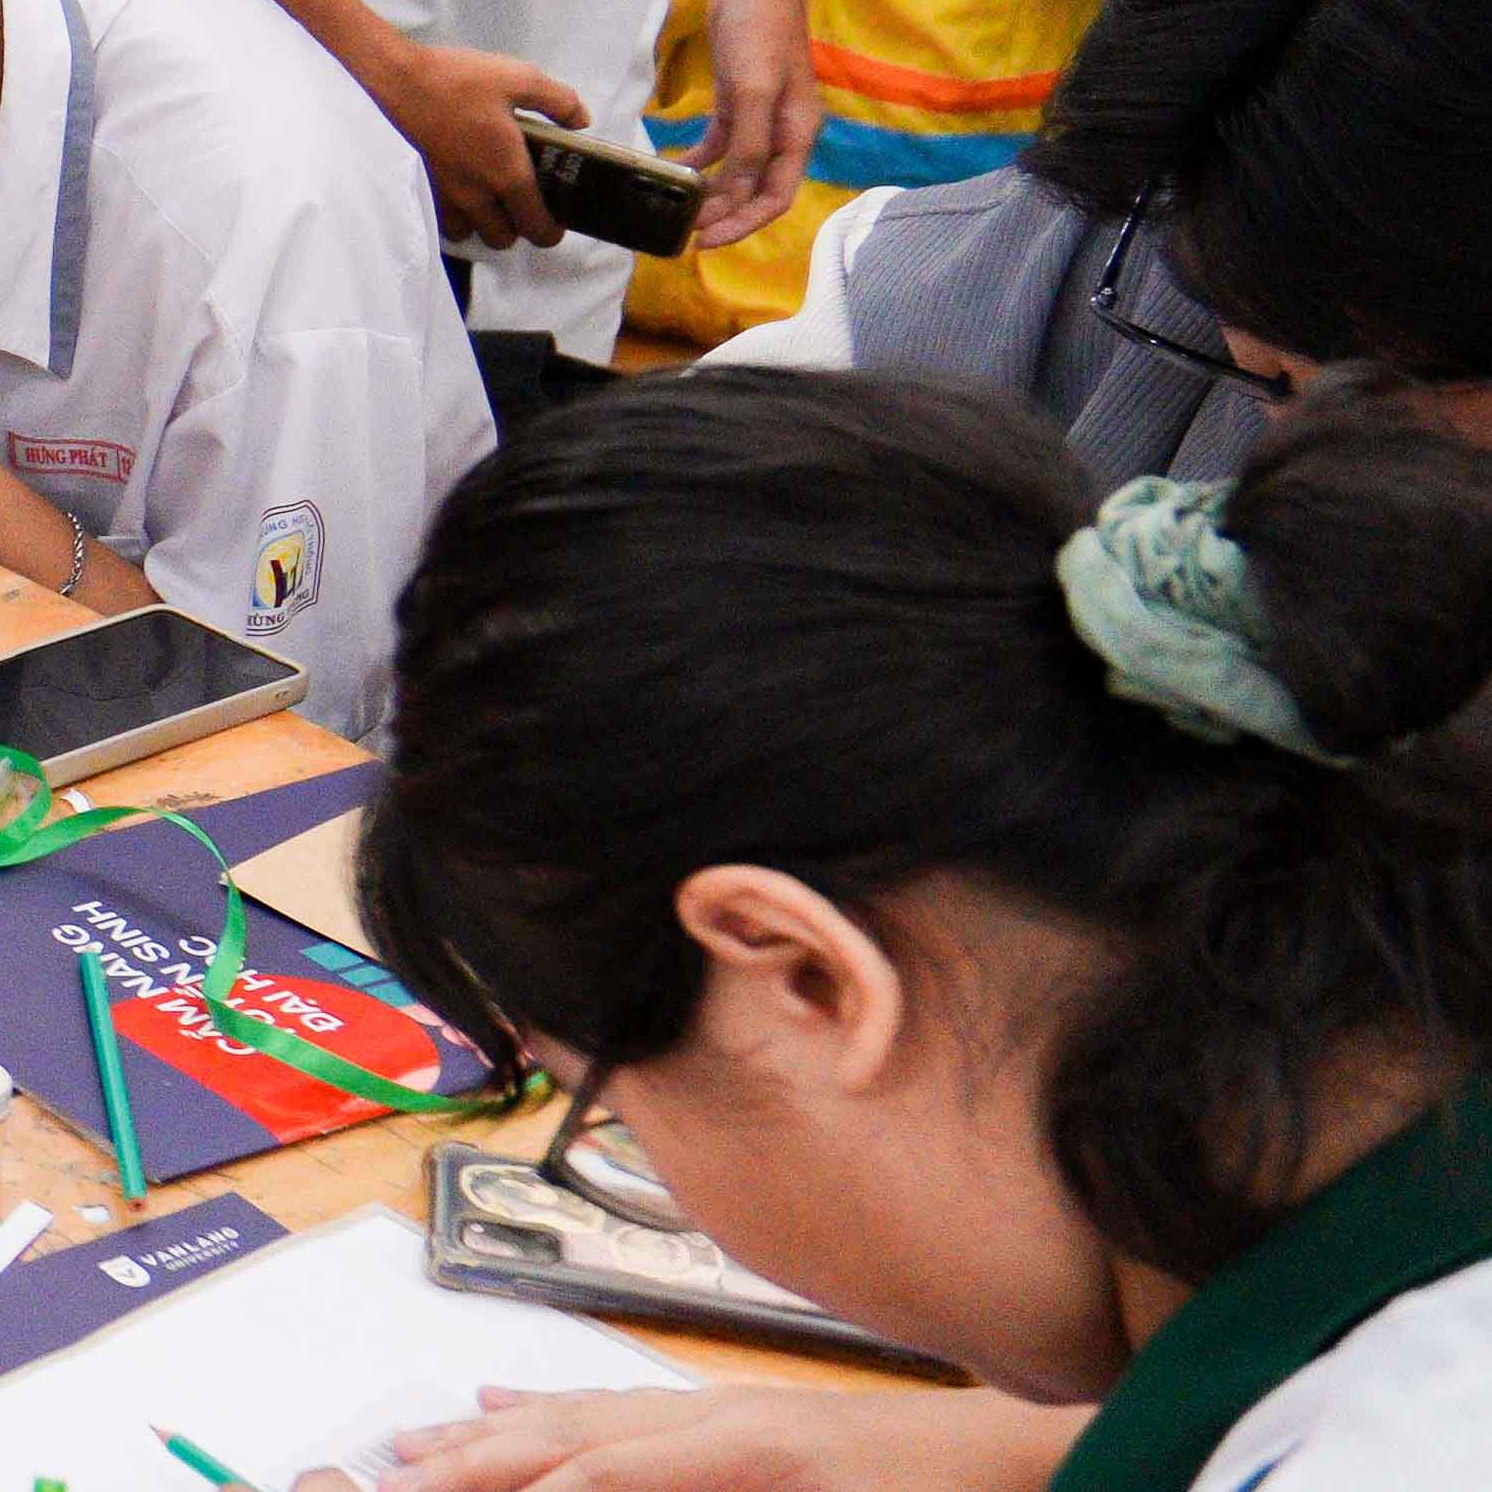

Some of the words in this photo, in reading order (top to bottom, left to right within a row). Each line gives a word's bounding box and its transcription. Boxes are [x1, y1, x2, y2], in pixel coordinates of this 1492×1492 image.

[68, 445, 107, 467] PHÁT
[70, 900, 171, 963] SINH
[178, 935, 277, 994] HC
[262, 990, 346, 1033] ĐẠI
